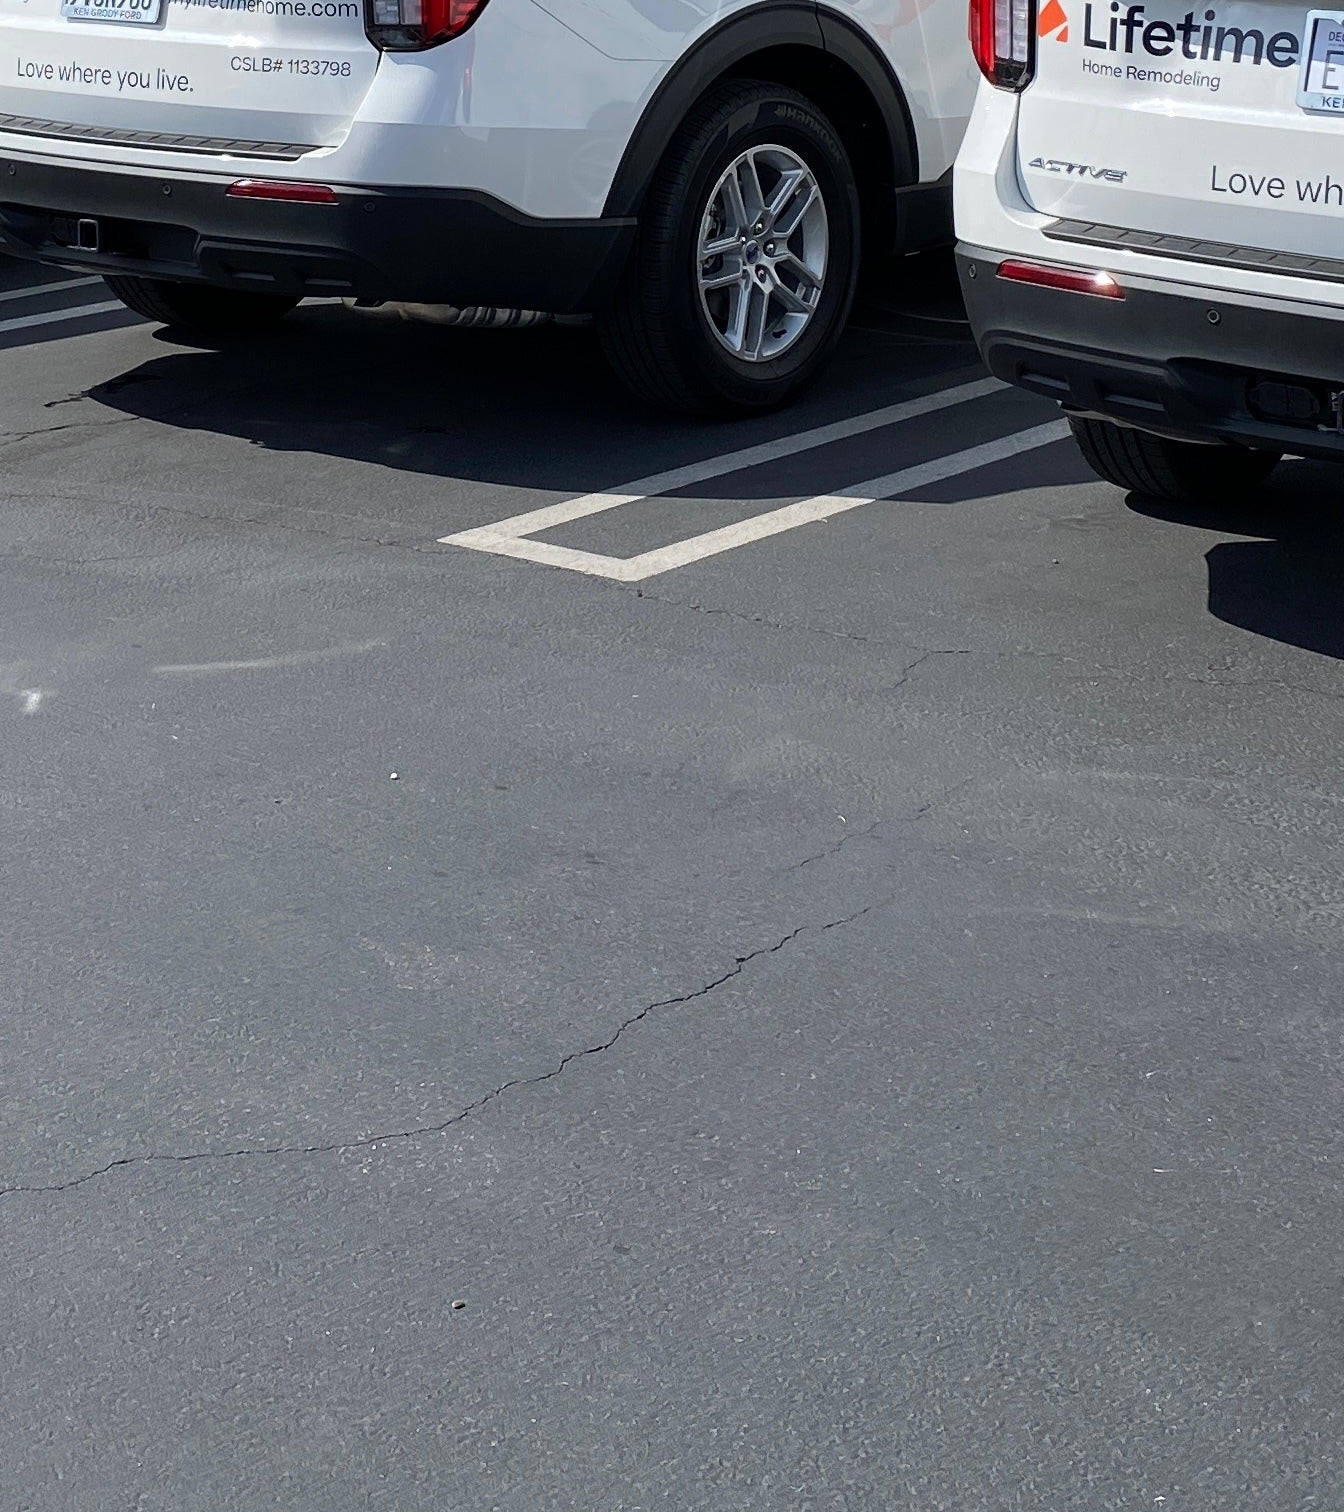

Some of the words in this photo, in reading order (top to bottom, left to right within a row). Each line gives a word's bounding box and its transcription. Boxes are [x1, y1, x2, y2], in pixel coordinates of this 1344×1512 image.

[1083, 0, 1299, 68] Lifetime
[16, 57, 54, 80] Love
[58, 60, 112, 85] where
[117, 69, 151, 92] you
[155, 67, 194, 92] live.
[230, 56, 283, 74] CSLB#
[287, 58, 352, 77] 1133798
[1082, 58, 1123, 78] Home
[1126, 65, 1222, 92] Remodeling
[1028, 157, 1128, 184] ACTIVE
[1210, 164, 1286, 199] Love
